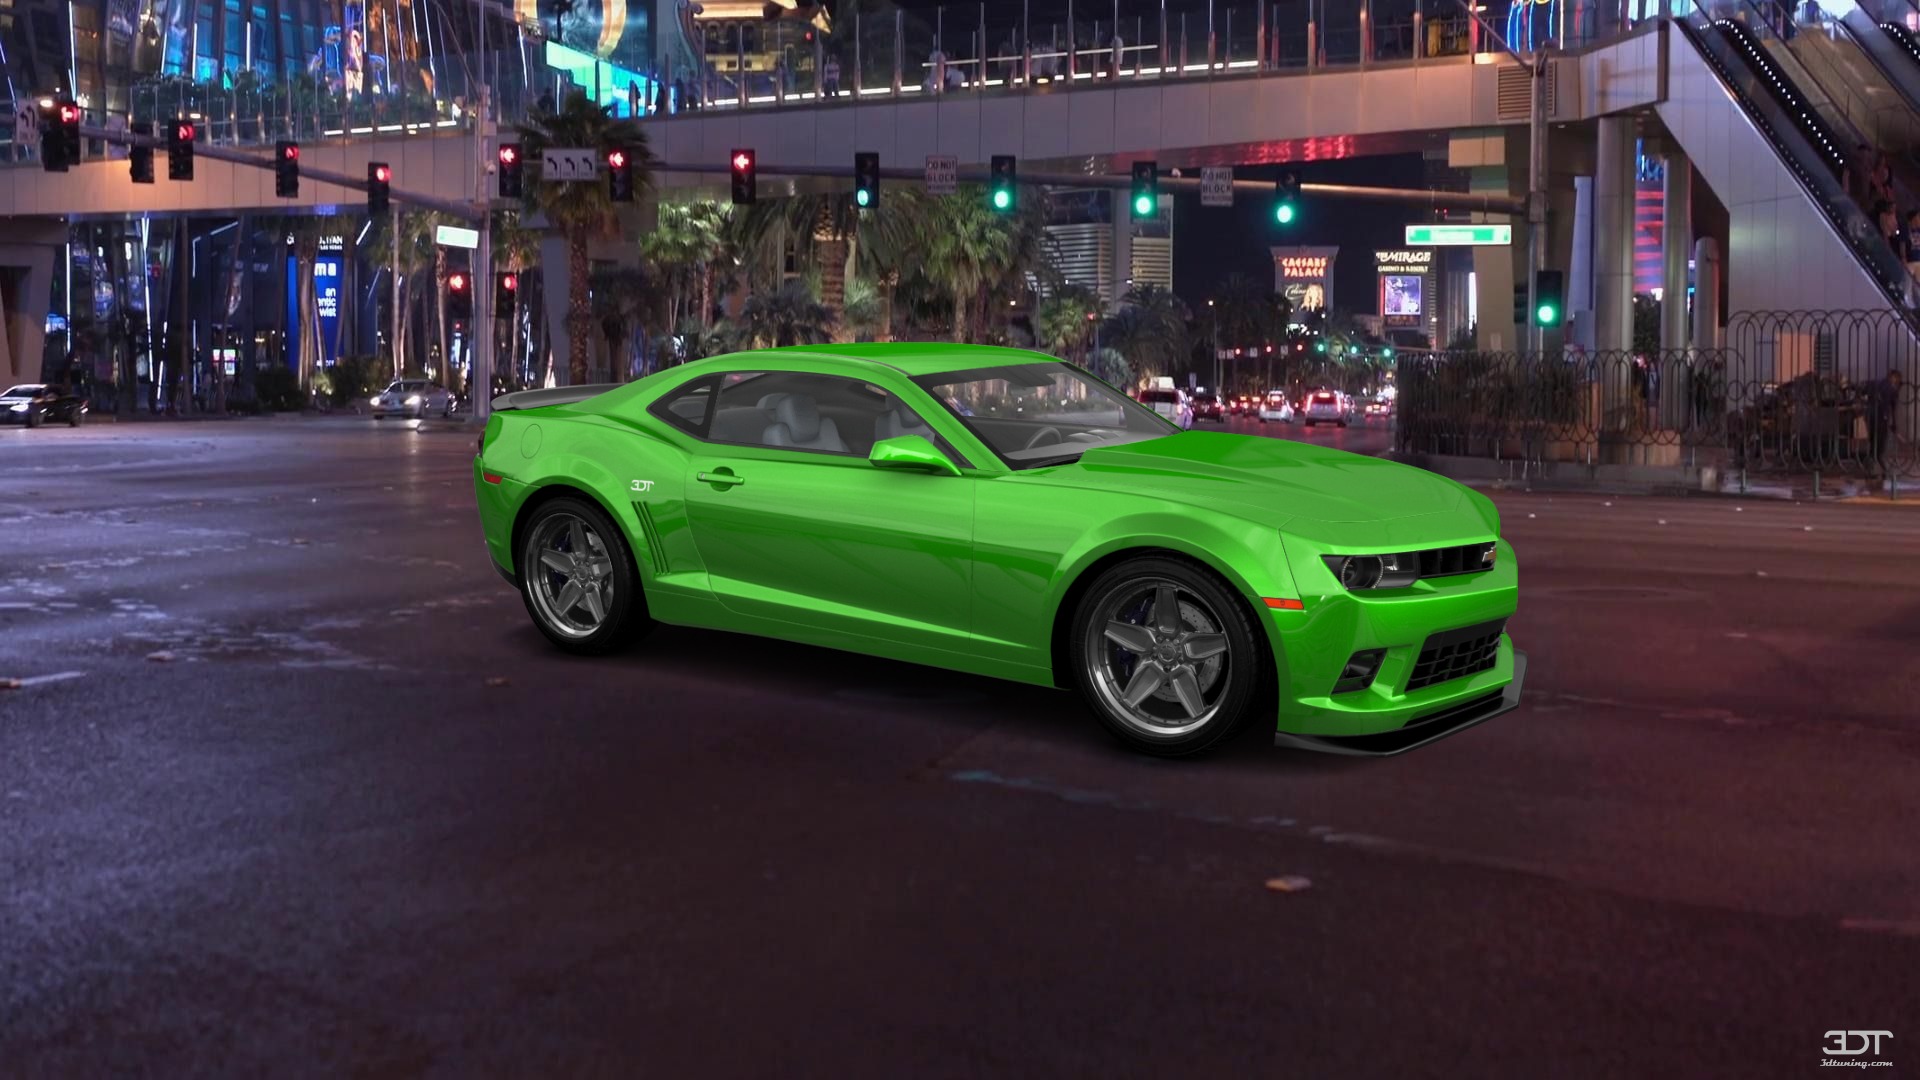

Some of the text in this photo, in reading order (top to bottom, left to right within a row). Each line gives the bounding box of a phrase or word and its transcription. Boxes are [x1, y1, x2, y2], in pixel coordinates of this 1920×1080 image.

[1282, 257, 1327, 267] CAESARS
[1383, 252, 1431, 263] MIRAGE
[1284, 267, 1324, 277] PALACE
[630, 479, 655, 492] 3DT
